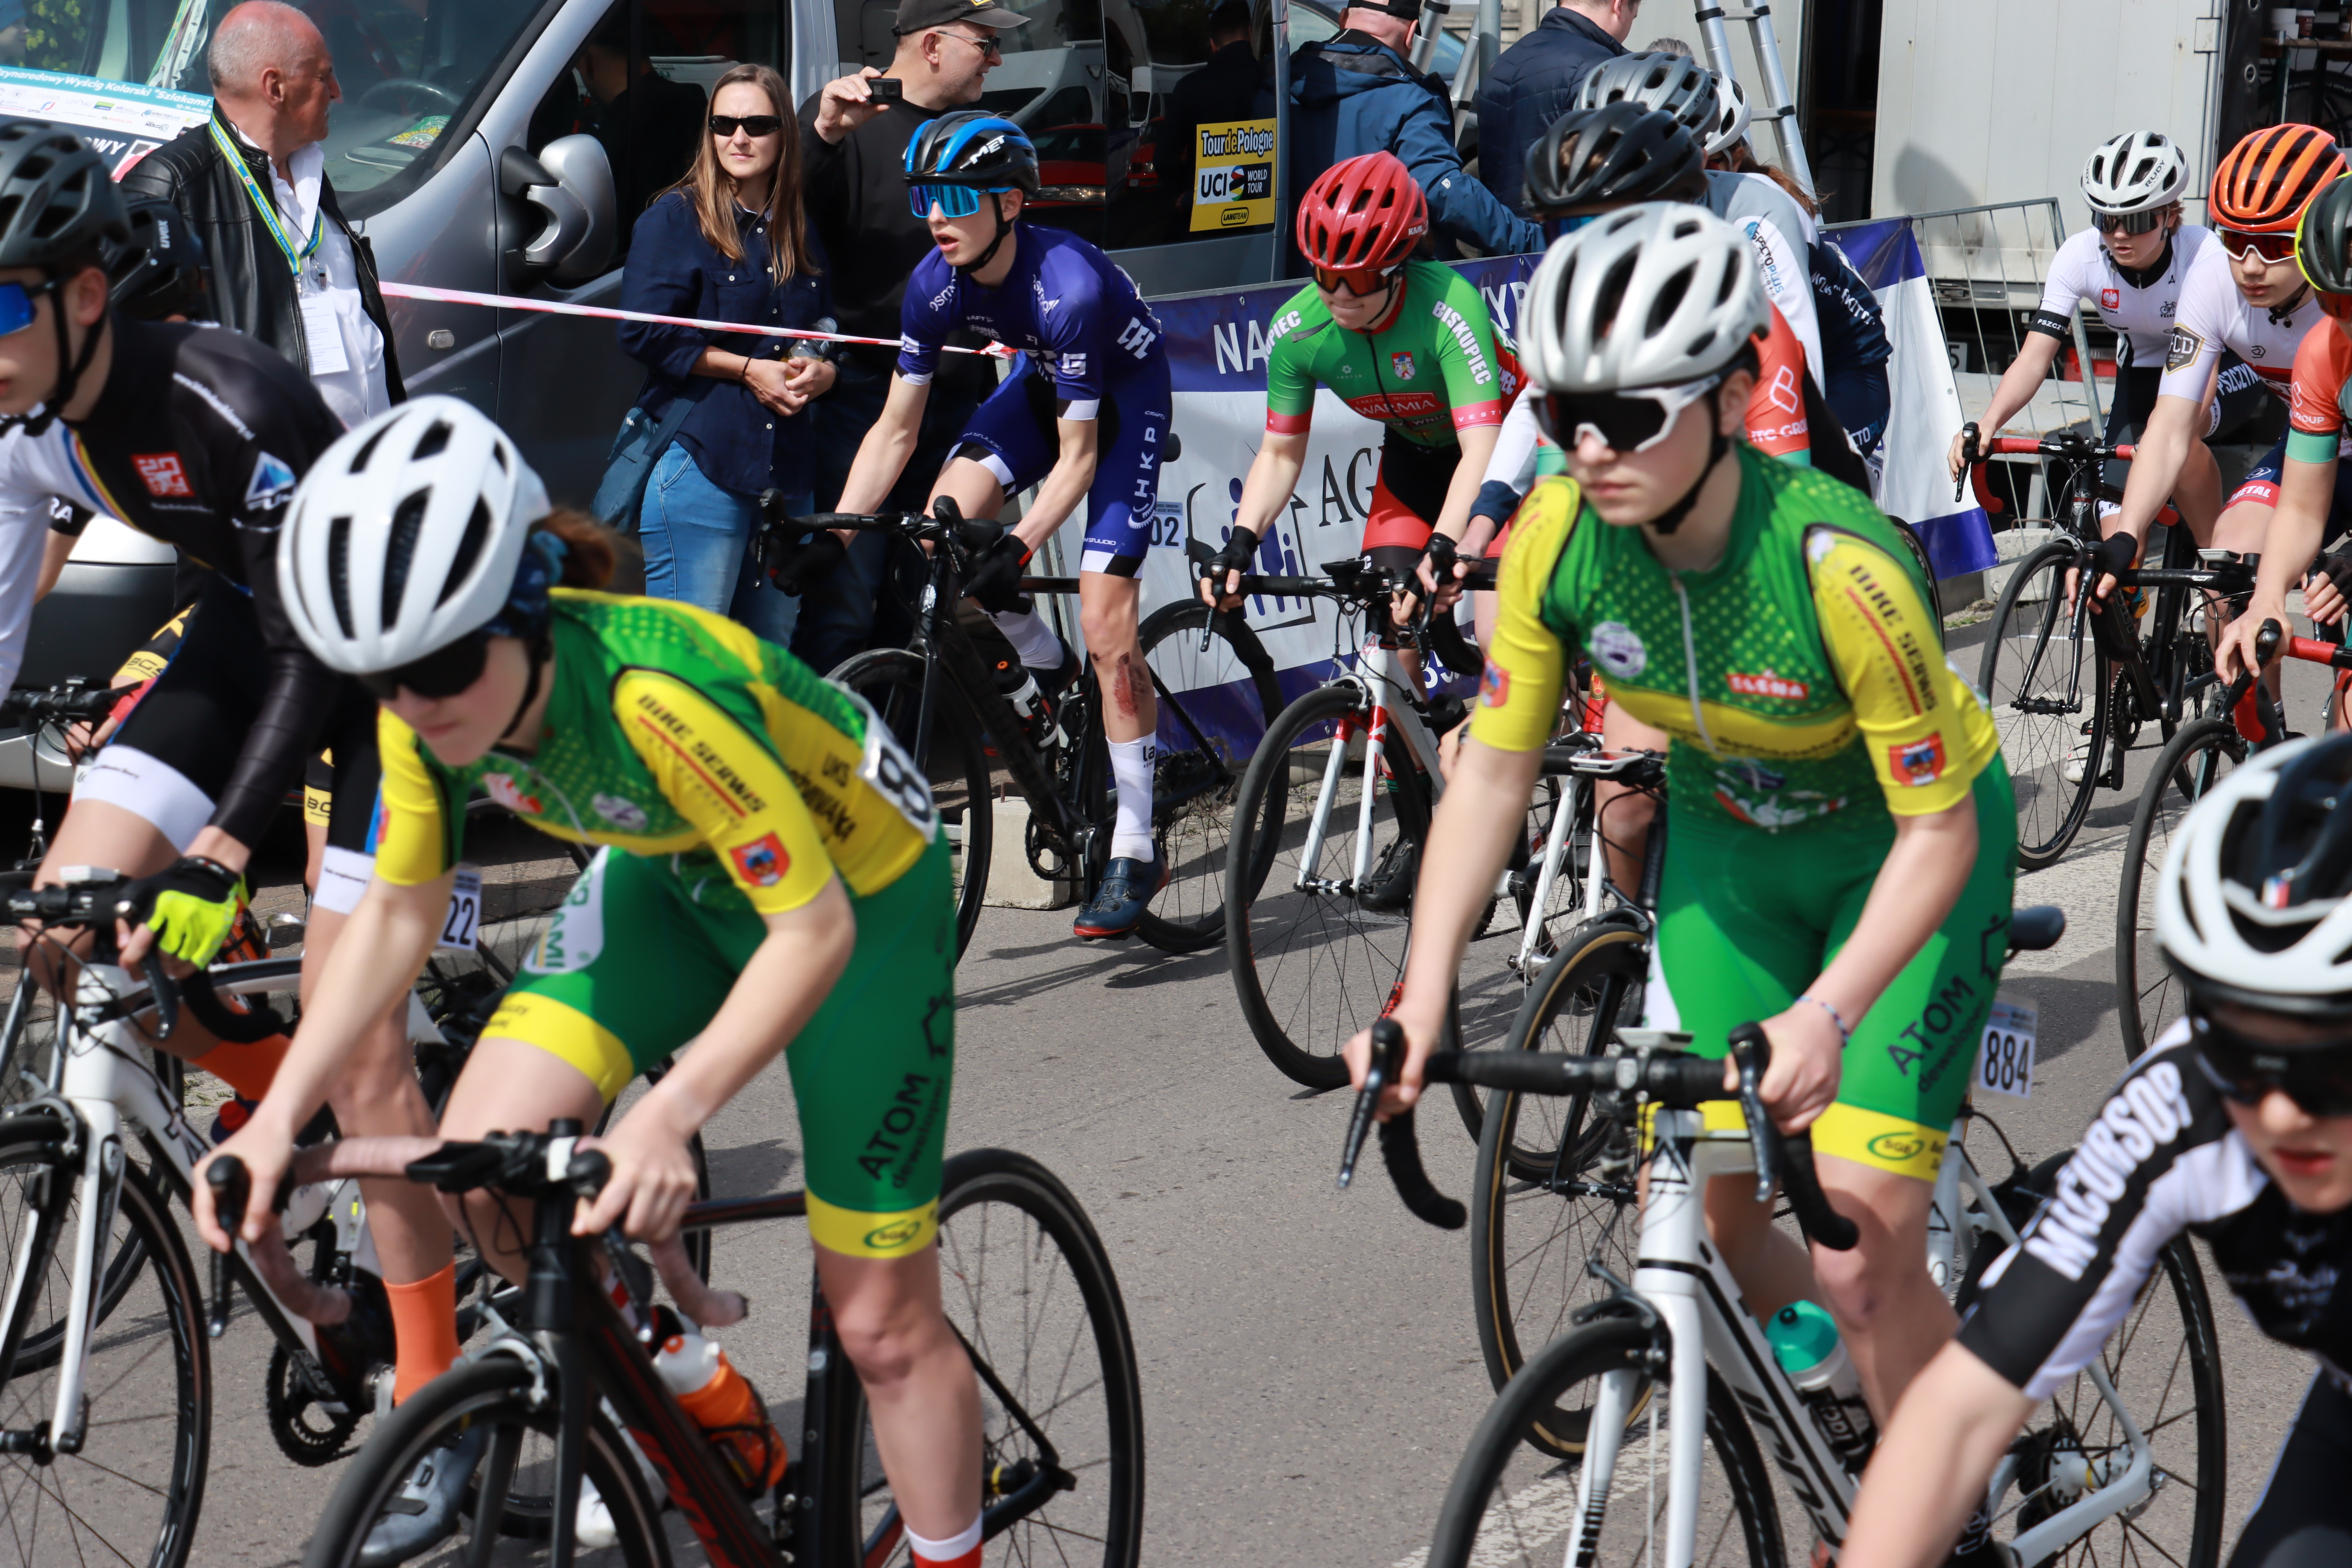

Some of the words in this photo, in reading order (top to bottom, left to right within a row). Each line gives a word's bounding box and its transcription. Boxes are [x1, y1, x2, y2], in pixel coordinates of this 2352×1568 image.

[65, 76, 104, 91] Wyścig
[105, 82, 152, 97] Kolarski
[970, 135, 1005, 165] MET
[1201, 172, 1227, 198] UCI
[1248, 169, 1267, 181] WORLD
[1248, 182, 1263, 194] TOUR
[2145, 159, 2166, 188] RUDY
[157, 219, 171, 248] uvex
[1214, 319, 1269, 374] NA
[1431, 299, 1493, 386] BISKUPIEC
[1354, 399, 1436, 415] WARMIA
[1134, 427, 1156, 498] HKP
[1850, 564, 1903, 627] BIKE
[637, 694, 694, 740] BIKE
[690, 741, 767, 812] SERWIS
[1886, 975, 1975, 1077] ATOM
[1984, 1030, 2031, 1095] 884
[857, 1072, 931, 1181] ATOM
